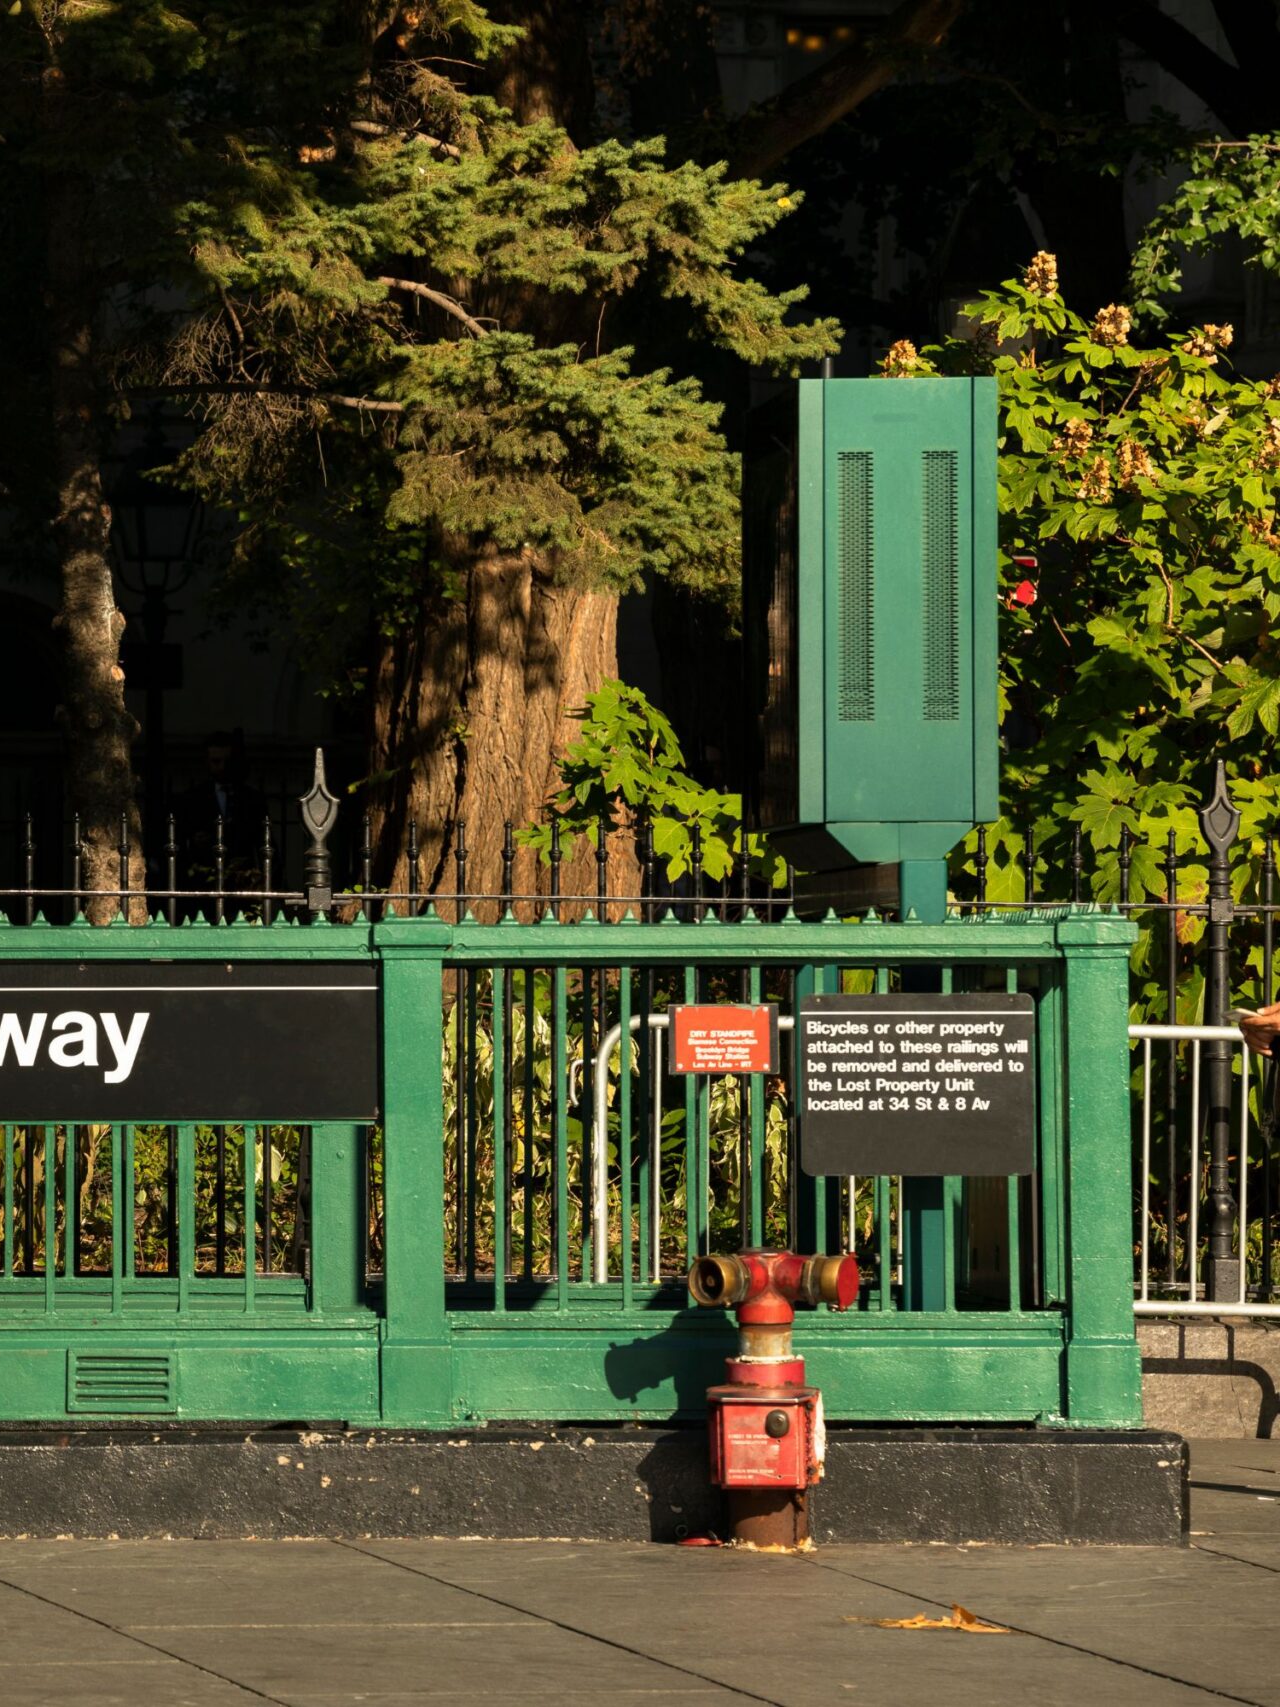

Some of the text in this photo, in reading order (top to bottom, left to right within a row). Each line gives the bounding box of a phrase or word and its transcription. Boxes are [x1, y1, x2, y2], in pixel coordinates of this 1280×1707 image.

[689, 1030, 708, 1038] DRY
[806, 1021, 1005, 1037] Bicycles or other property
[807, 1040, 1029, 1056] attached to these railings will
[807, 1059, 1025, 1073] be removed and delivered to
[807, 1078, 975, 1094] the Lost Property Unit
[807, 1097, 991, 1111] located at 34 St & 8 Av
